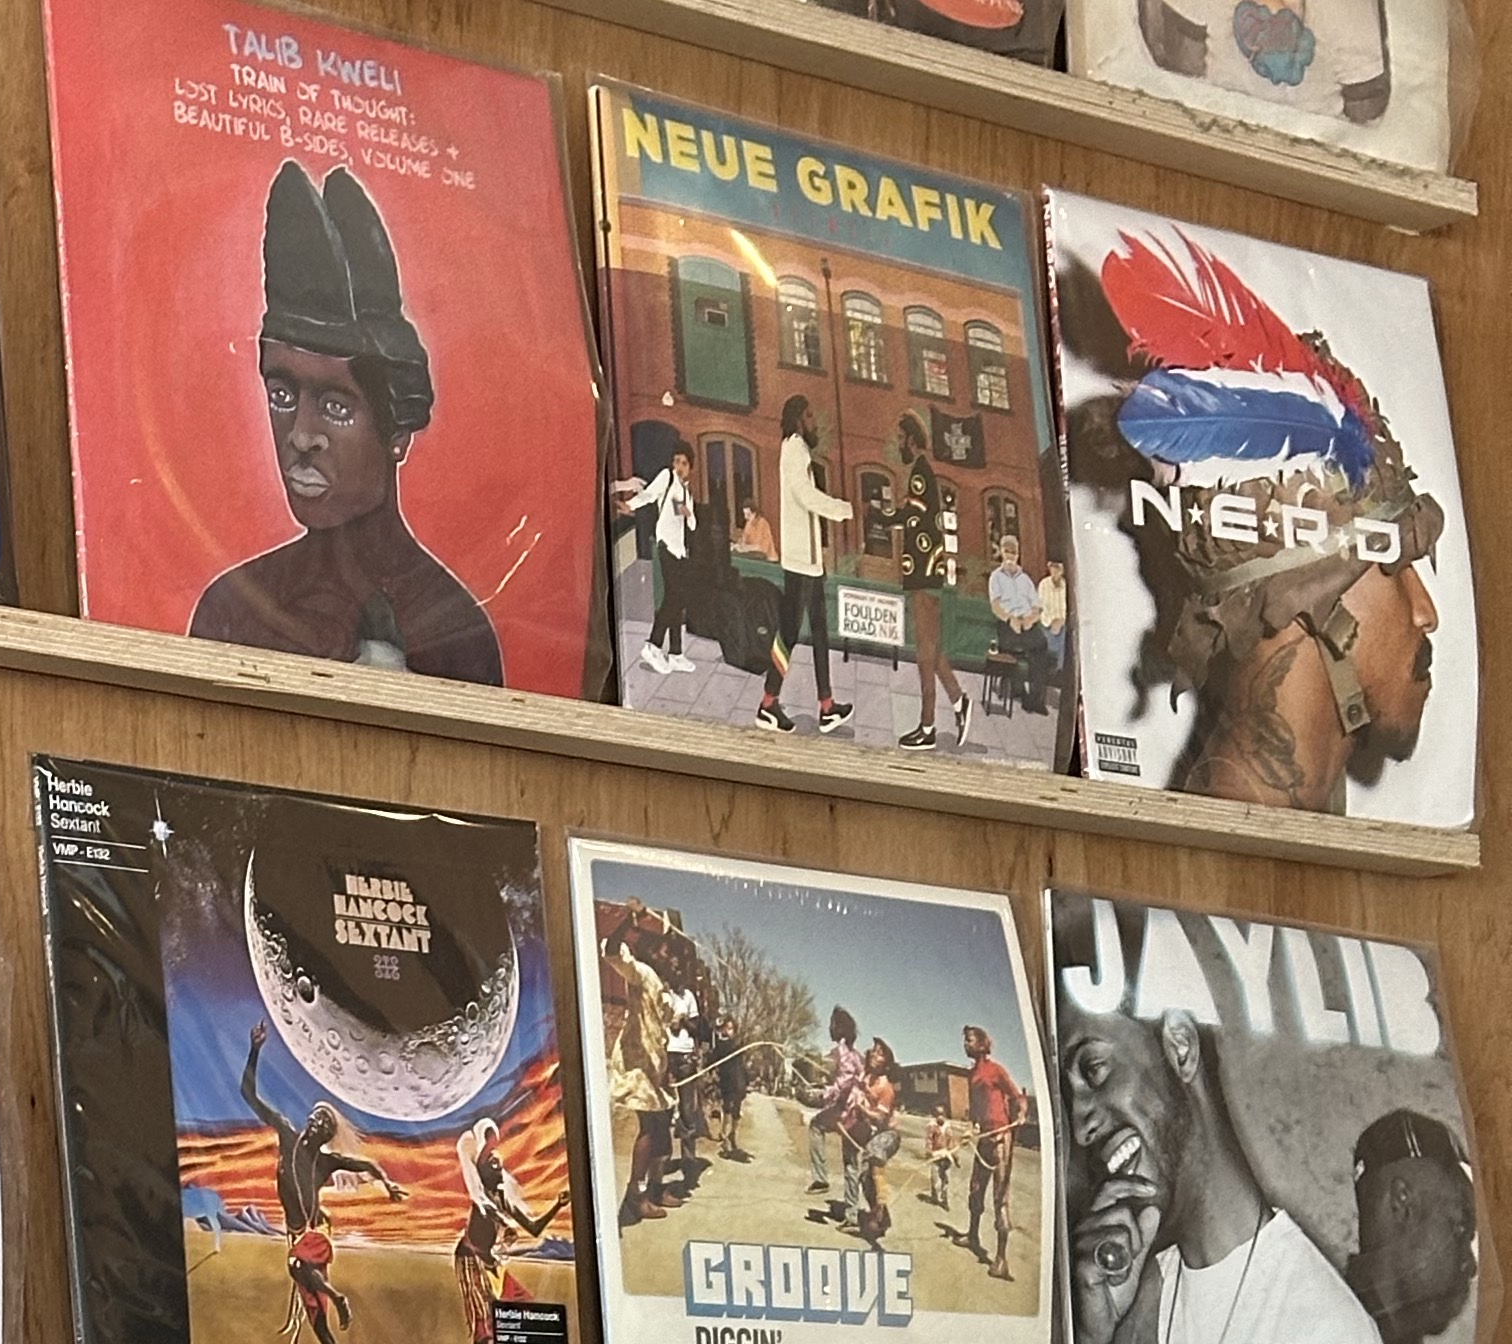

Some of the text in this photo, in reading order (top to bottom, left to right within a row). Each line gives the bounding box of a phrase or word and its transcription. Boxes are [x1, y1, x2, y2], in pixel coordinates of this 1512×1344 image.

[222, 23, 402, 95] TALIB KWELI
[230, 63, 416, 125] TRAIN OF THOUGHT:
[174, 78, 439, 156] LOST LYRICS, RARE RELEASES
[174, 101, 476, 190] BEAUTIFUL B-SIDES, VOLUME ONE
[621, 108, 779, 193] NEUE
[795, 155, 1003, 251] GRAFIK
[844, 602, 897, 623] FOULDEN
[48, 777, 93, 796] Herbie
[49, 794, 111, 817] Hancock
[50, 813, 101, 834] Sextant
[86, 846, 111, 860] E132
[345, 874, 414, 902] HERBIE
[333, 894, 430, 926] HANCOCK
[335, 919, 431, 953] SEXTANT
[1061, 898, 1442, 1057] JAYLIB
[686, 1240, 914, 1326] GROOVE
